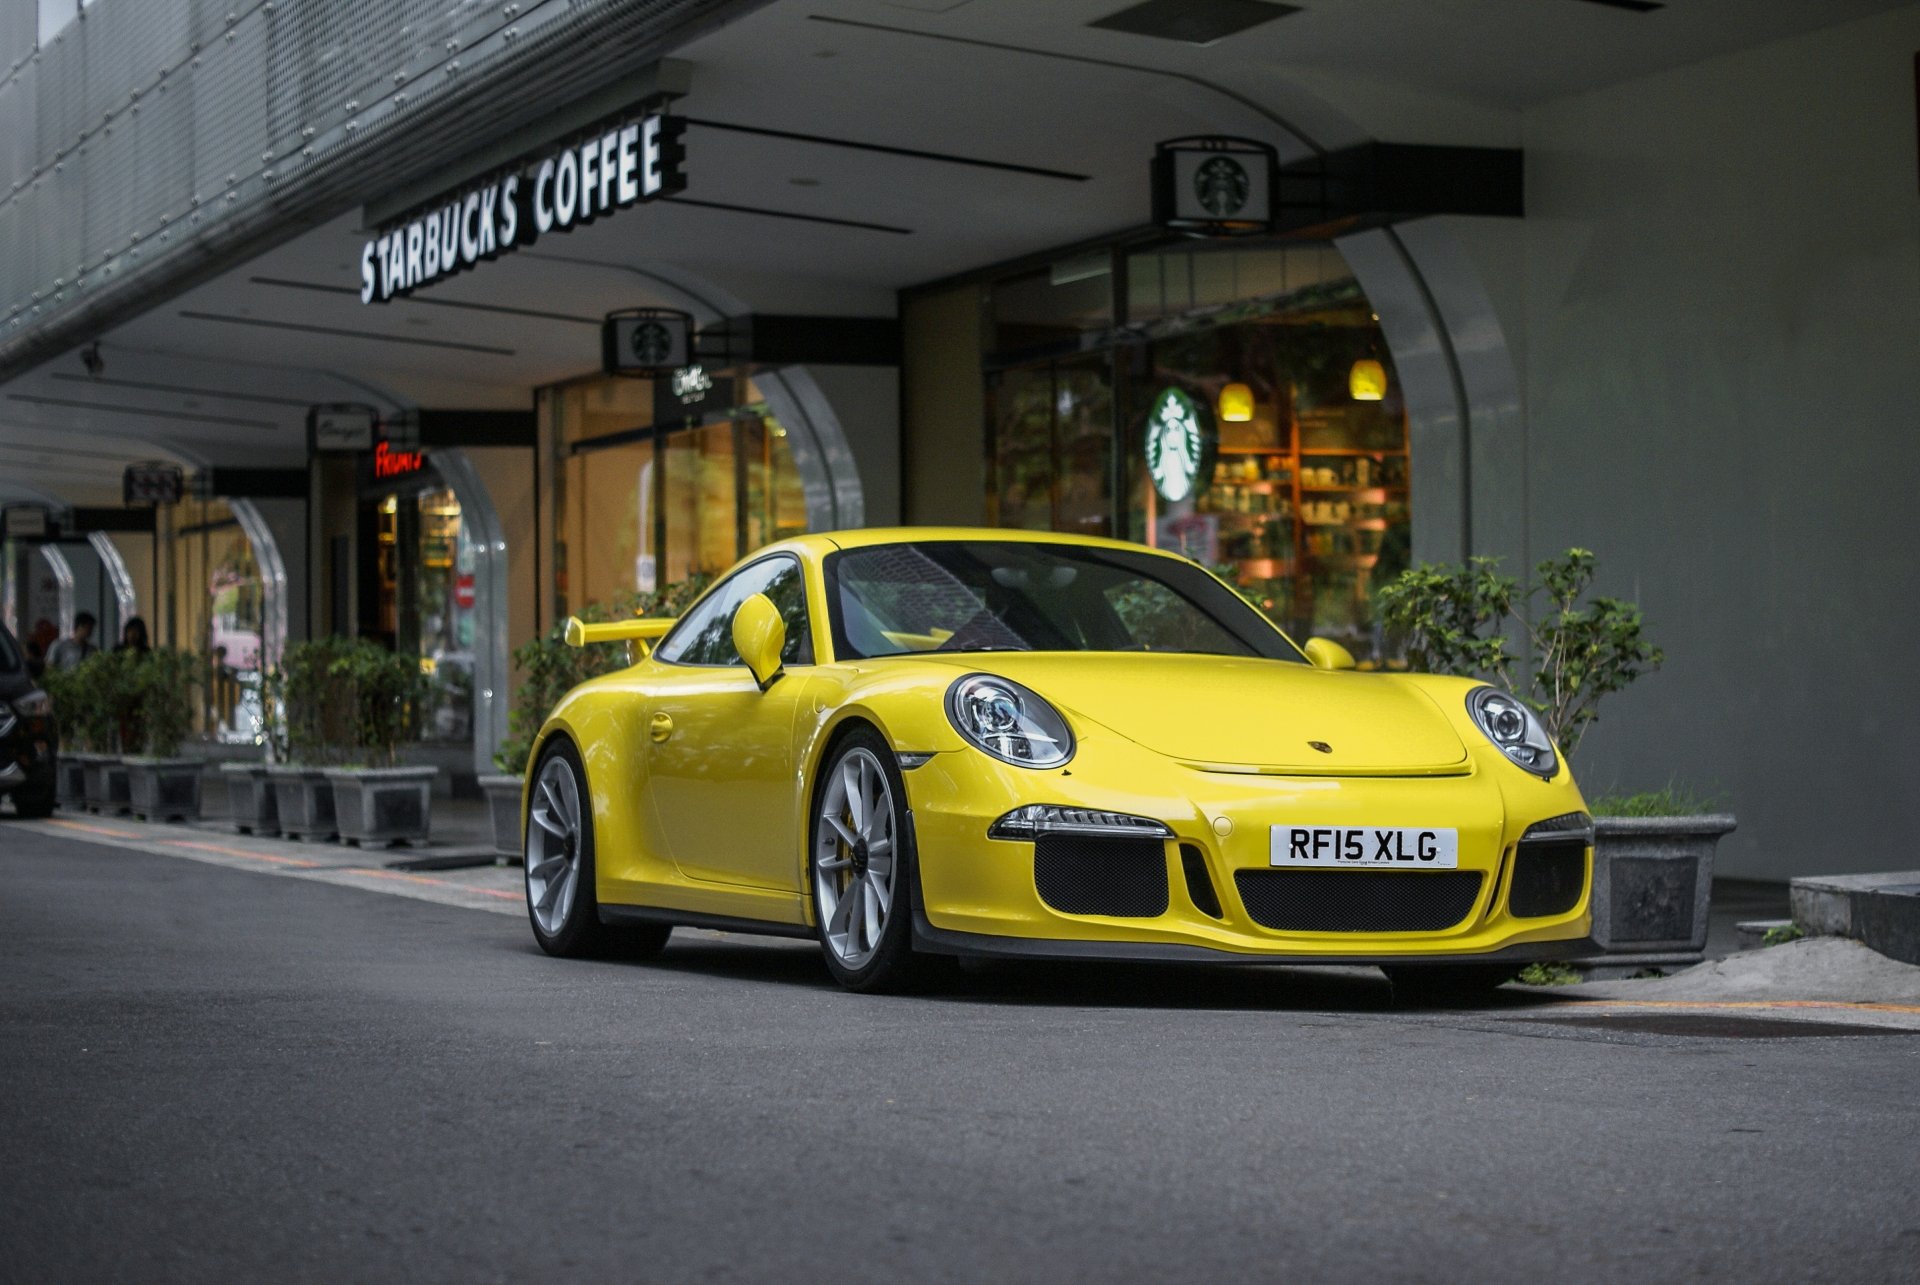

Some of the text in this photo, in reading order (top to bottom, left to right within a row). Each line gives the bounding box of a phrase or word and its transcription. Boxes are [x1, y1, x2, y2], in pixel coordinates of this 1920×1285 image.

[361, 114, 662, 305] STARBUCKS COFFEE
[1290, 829, 1437, 861] RF15 XLG
